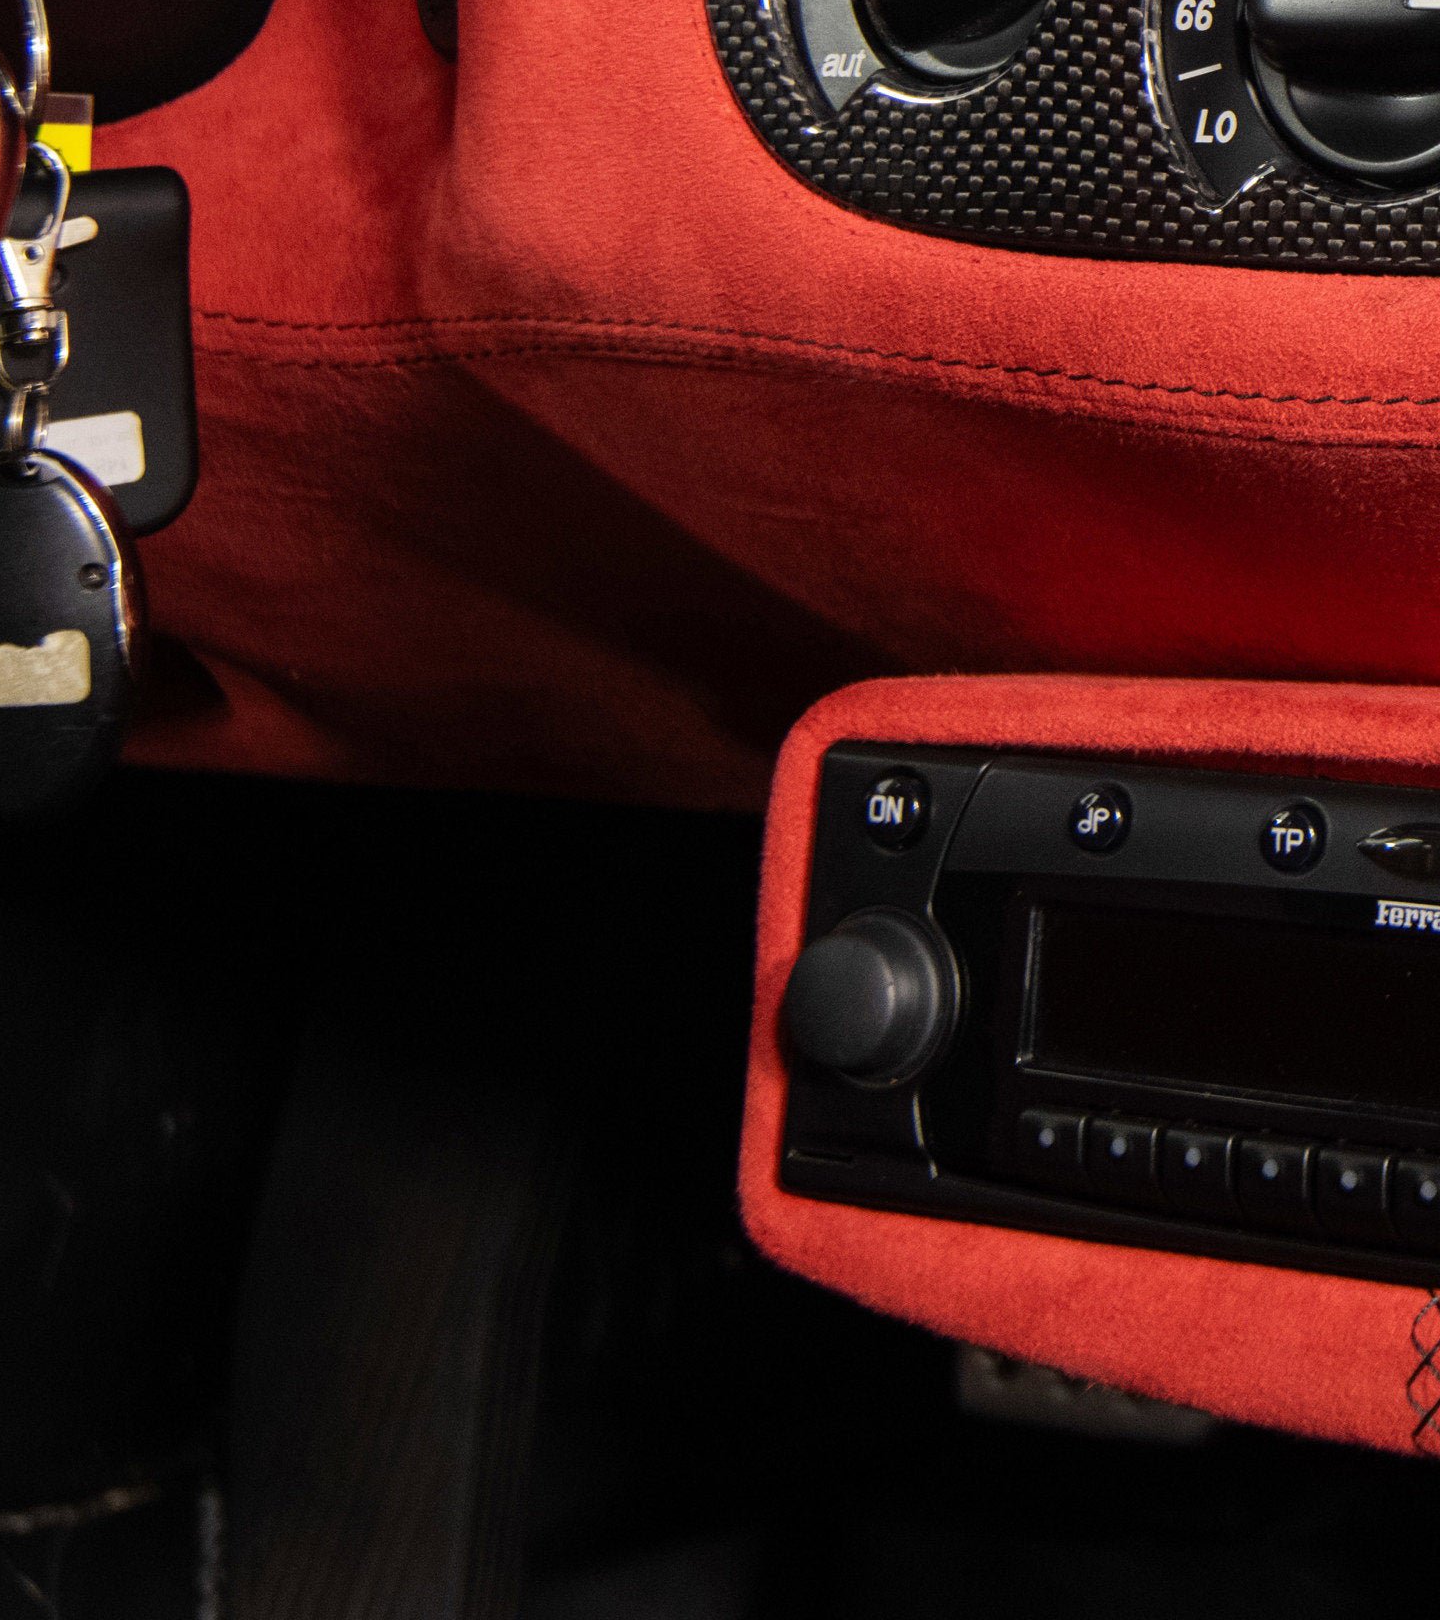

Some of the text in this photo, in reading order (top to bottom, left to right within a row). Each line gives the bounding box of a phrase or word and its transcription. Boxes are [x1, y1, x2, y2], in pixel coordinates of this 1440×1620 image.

[821, 48, 867, 78] aut
[1194, 108, 1238, 144] LO
[868, 794, 904, 824] ON
[1271, 826, 1303, 853] TP
